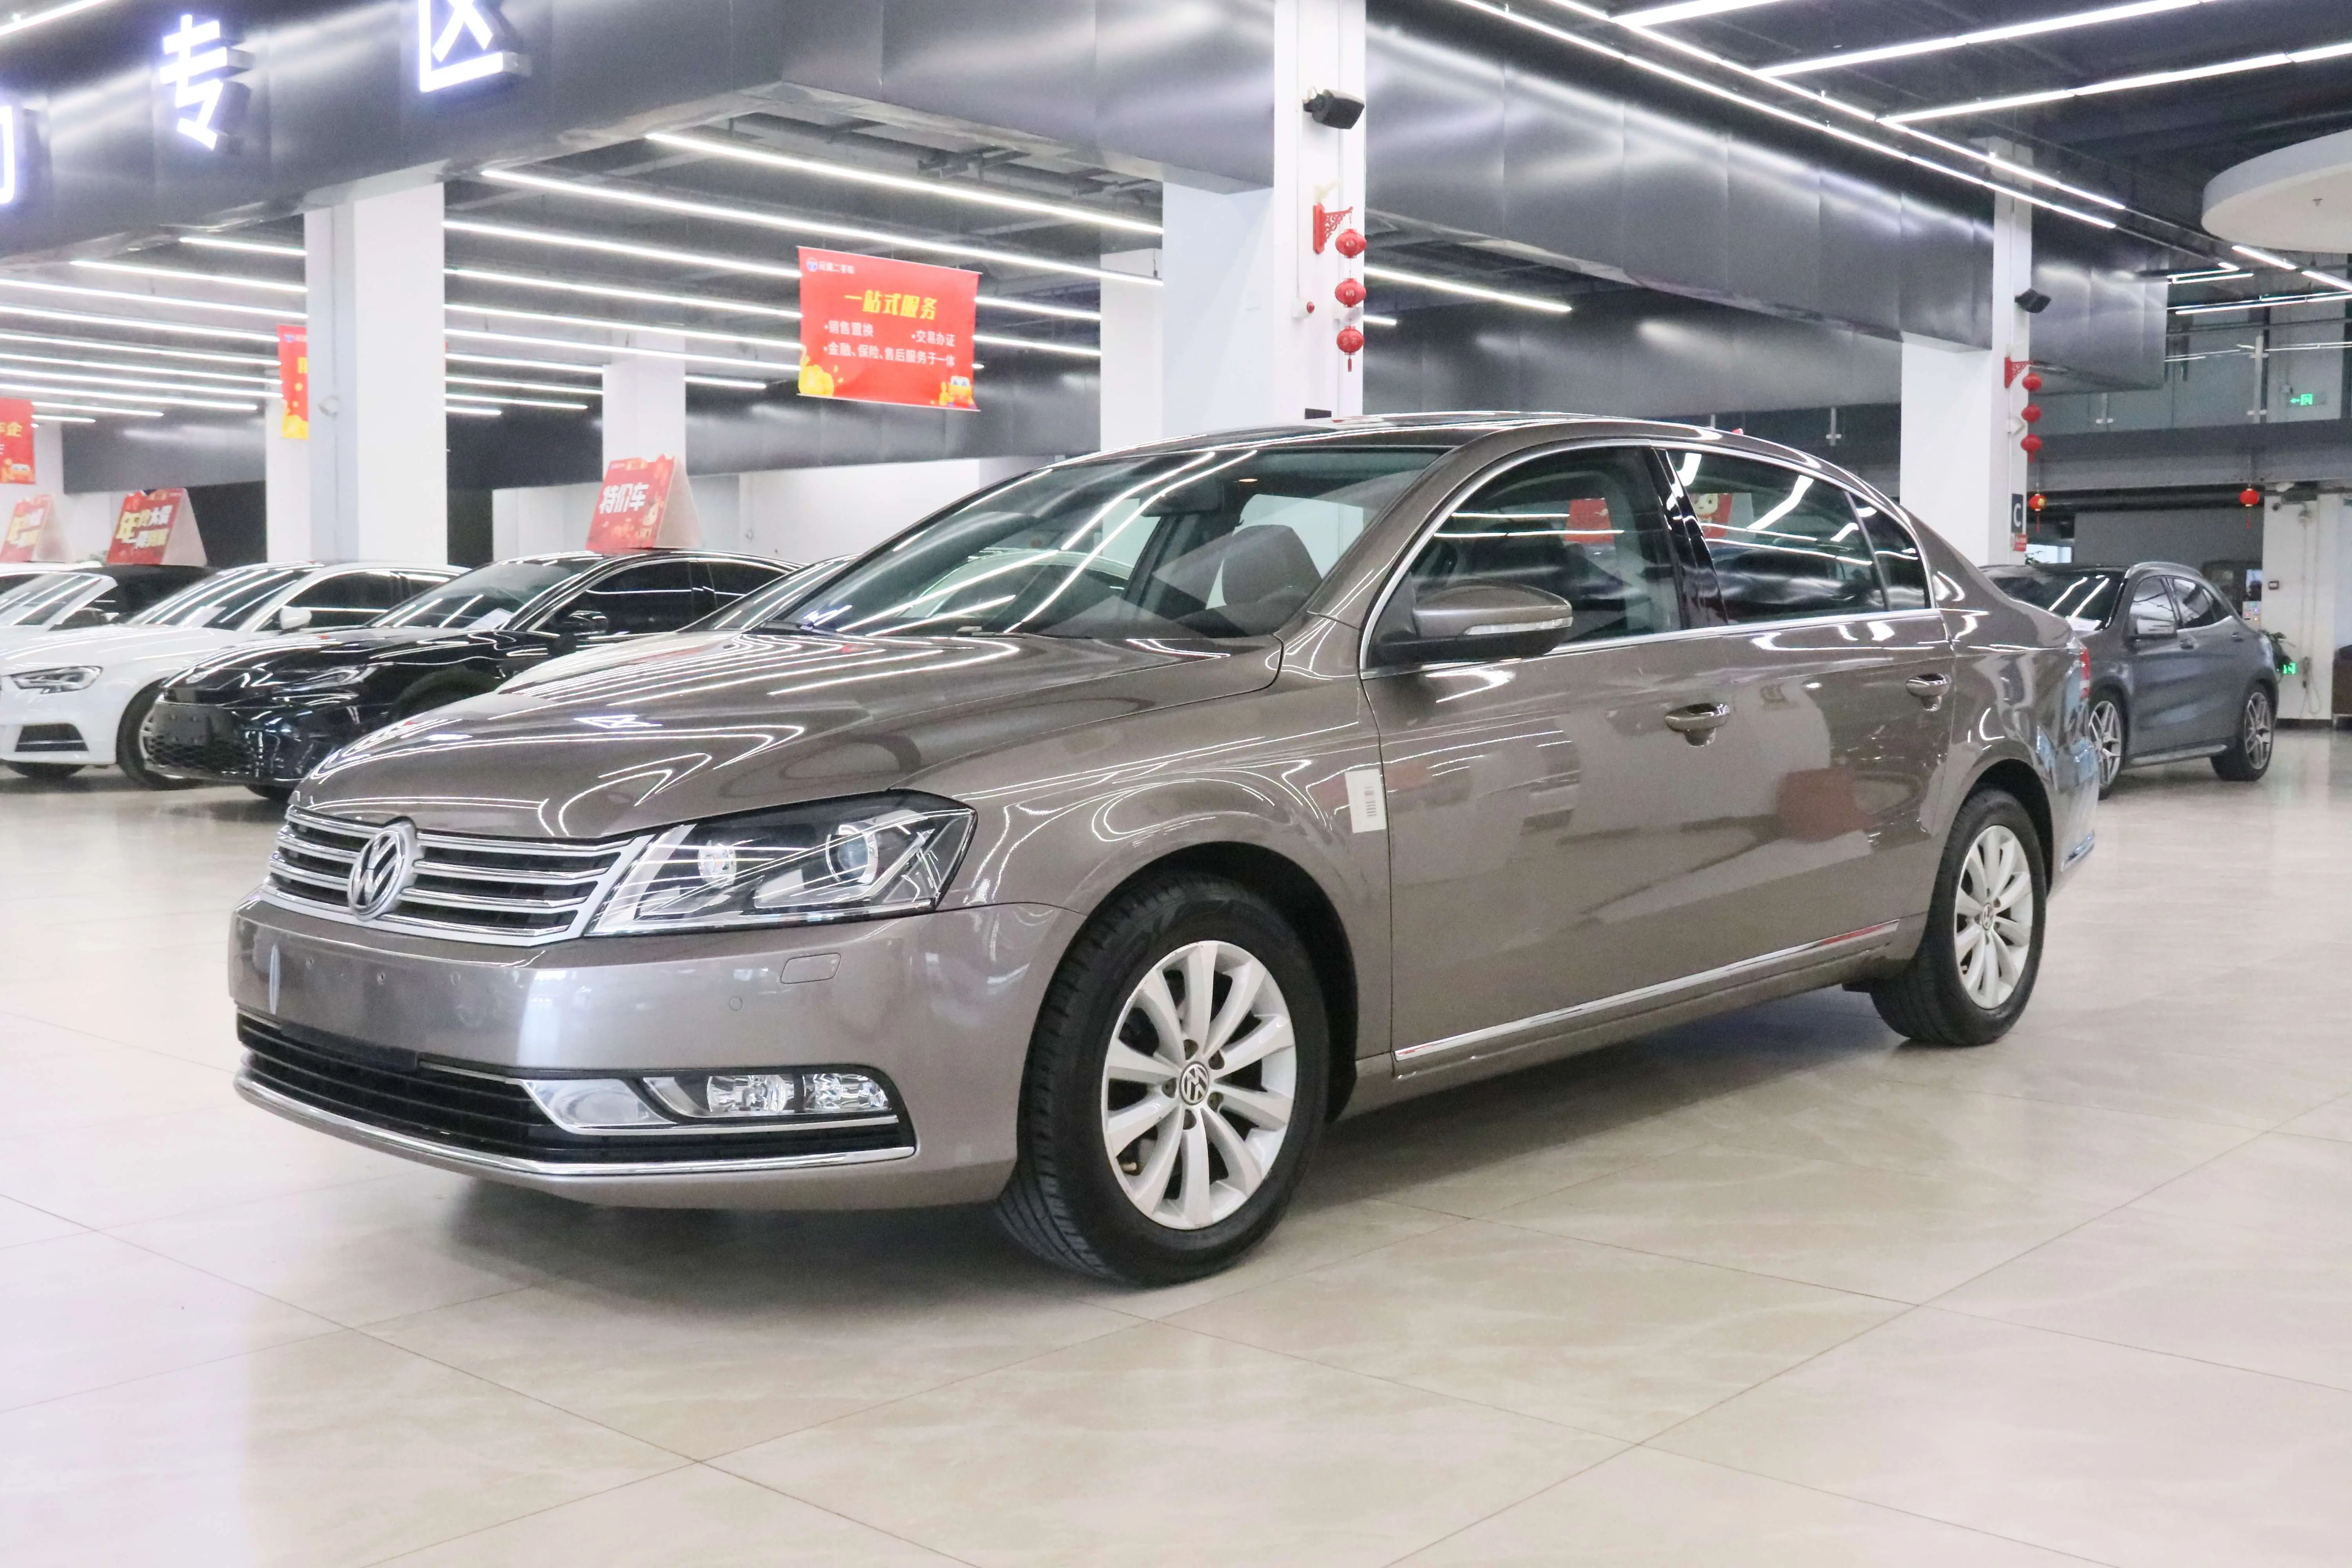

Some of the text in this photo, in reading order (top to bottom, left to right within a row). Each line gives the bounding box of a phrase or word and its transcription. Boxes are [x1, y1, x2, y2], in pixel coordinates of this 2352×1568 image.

[844, 289, 938, 320] 一站式服务
[599, 482, 649, 514] 特价车
[2013, 503, 2022, 527] C
